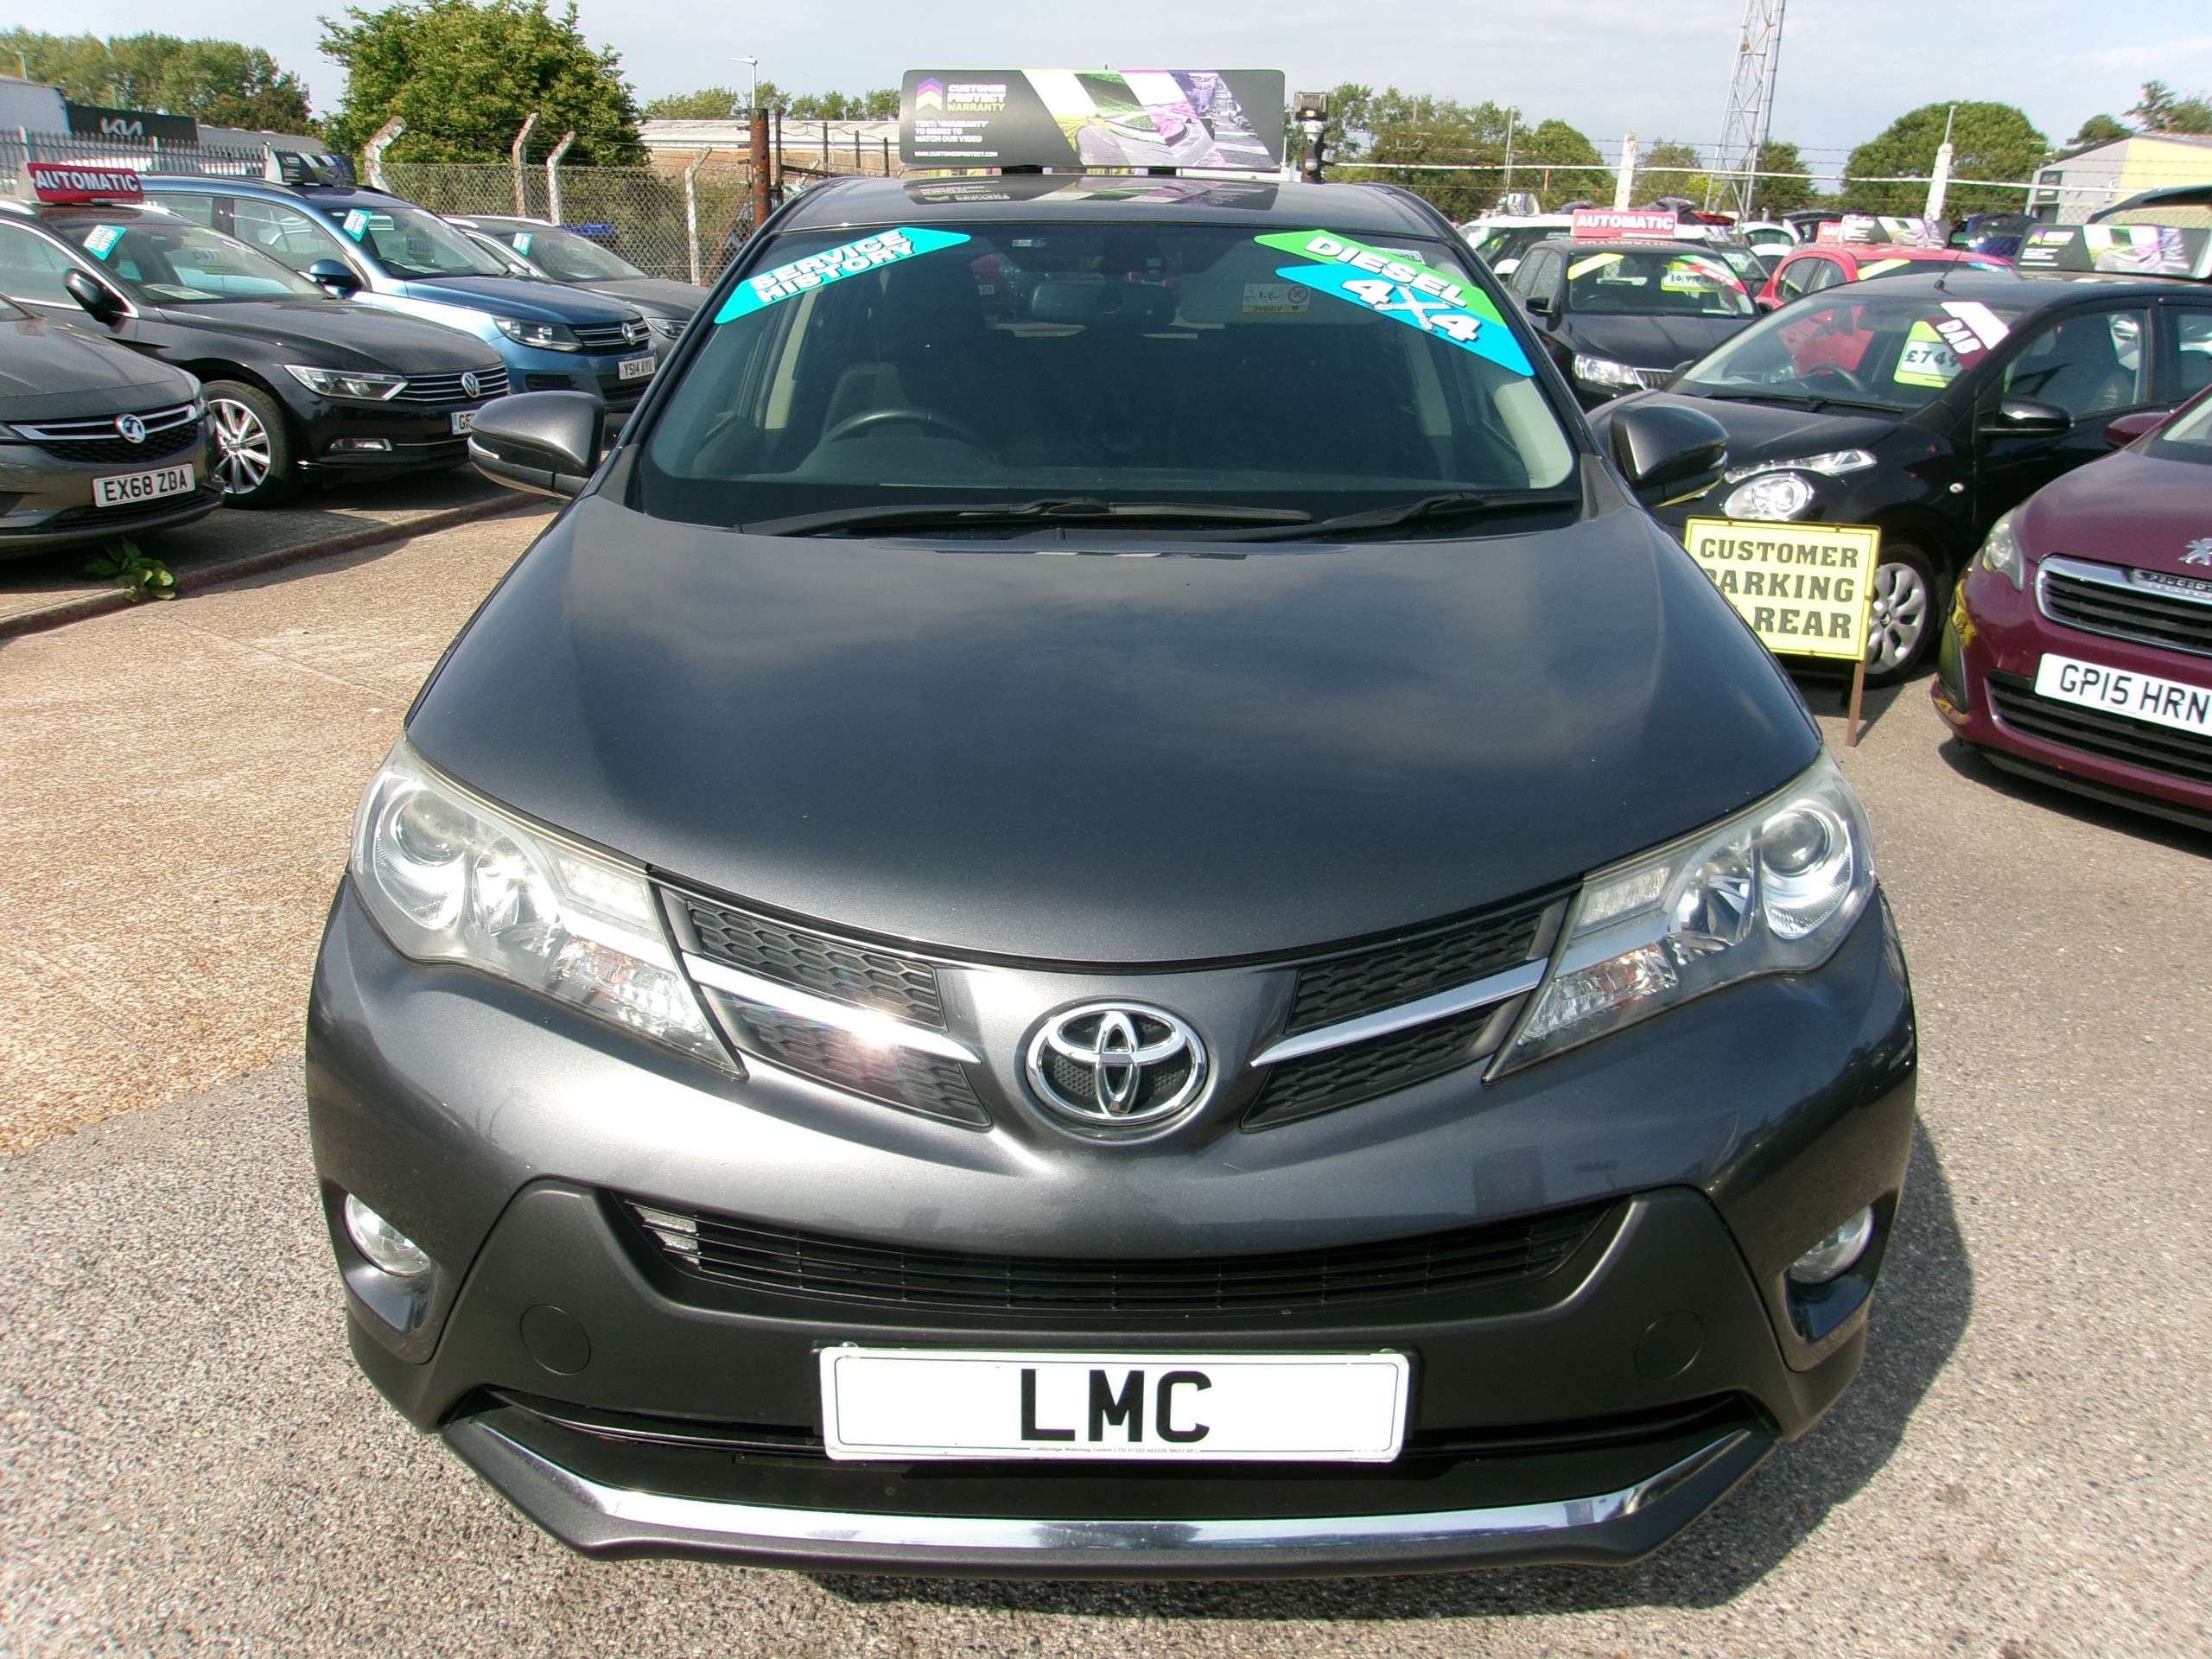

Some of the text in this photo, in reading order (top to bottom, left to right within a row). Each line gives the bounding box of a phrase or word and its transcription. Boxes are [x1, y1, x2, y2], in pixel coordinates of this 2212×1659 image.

[947, 103, 1006, 112] WARRANTY
[34, 170, 139, 193] AUTOMATIC
[1575, 214, 1675, 231] AUTOMATIC
[749, 231, 909, 290] SERVICE
[755, 241, 916, 303] HISTORY
[1304, 237, 1467, 308] DIESEL
[1936, 319, 1983, 354] DAB
[104, 477, 153, 502] EX68
[1700, 537, 1859, 569] CUSTOMER
[1752, 606, 1852, 639] REAR
[2059, 664, 2210, 724] GP15 HRN
[1020, 1368, 1212, 1443] LMC
